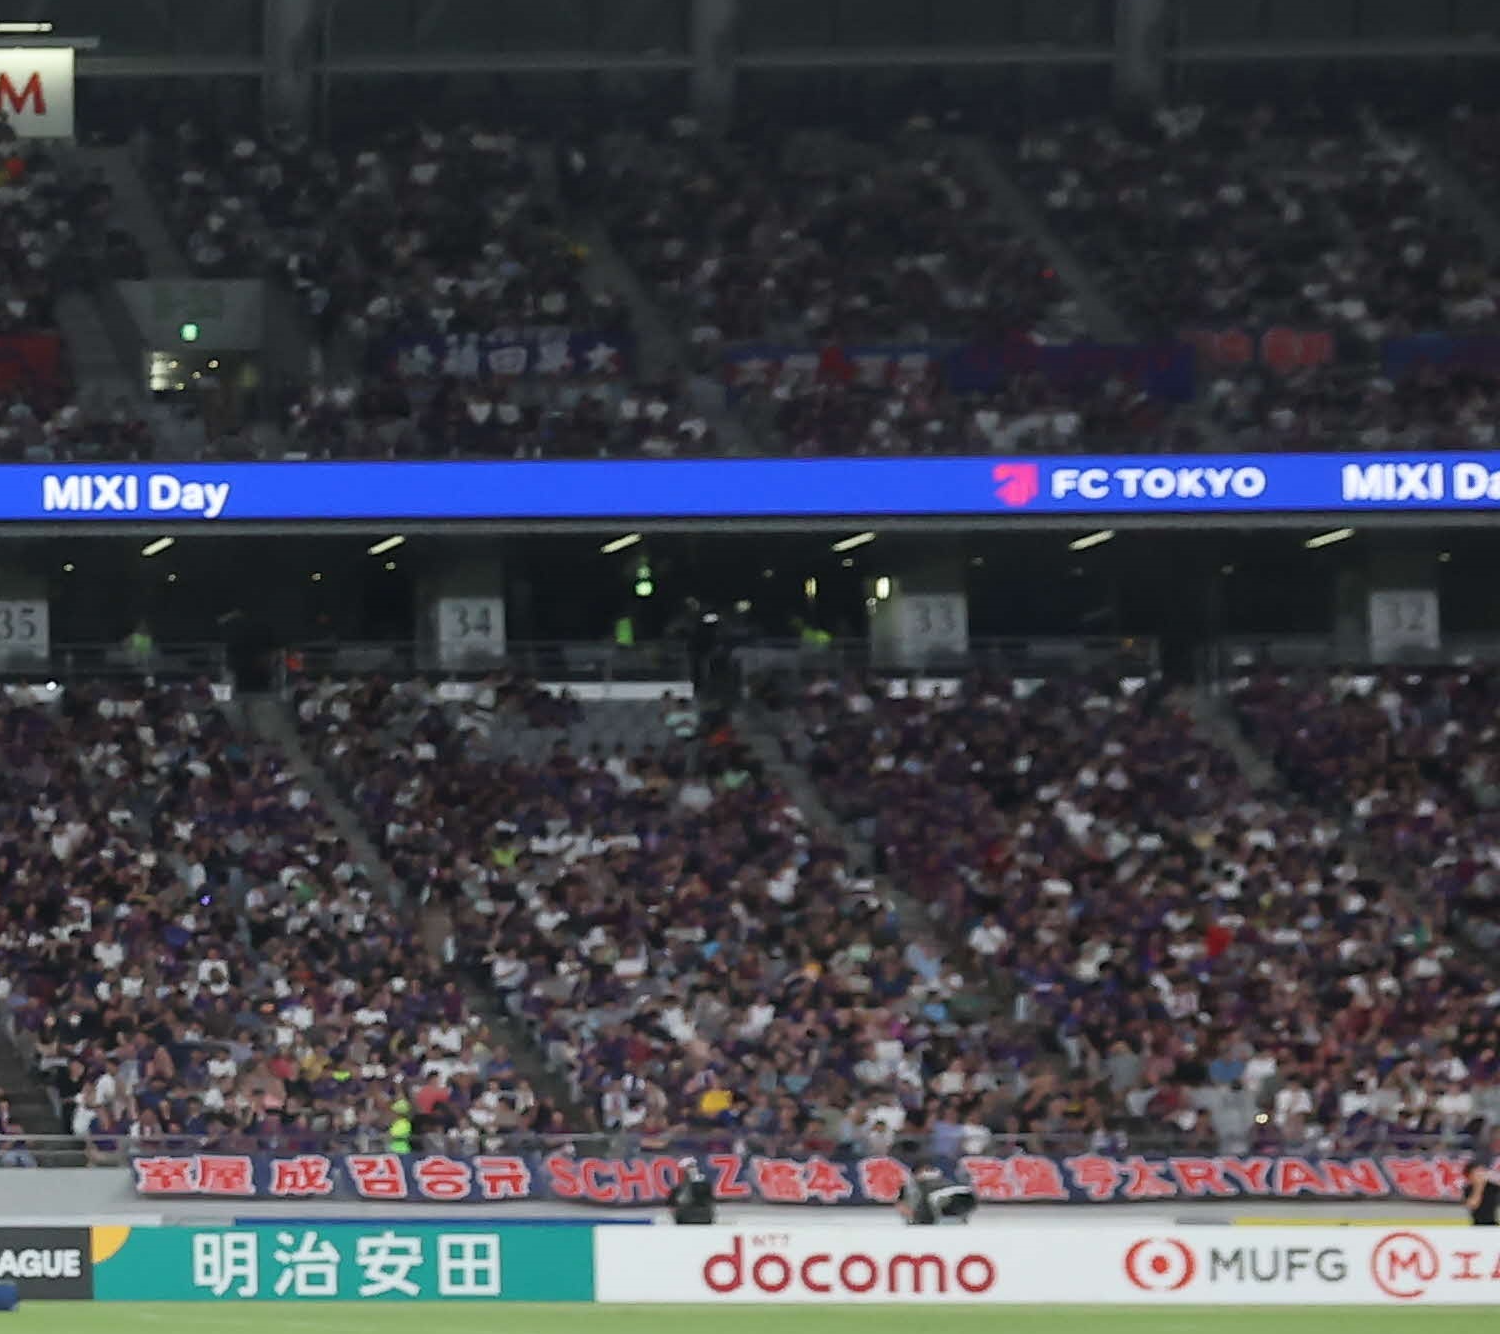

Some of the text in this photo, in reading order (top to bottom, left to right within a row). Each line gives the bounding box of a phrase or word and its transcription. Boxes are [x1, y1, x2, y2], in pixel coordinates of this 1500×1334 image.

[42, 475, 230, 519] MIXI Day
[1050, 466, 1267, 499] FC TOKYO
[1341, 463, 1500, 501] MIXI Da
[451, 605, 491, 639] 34
[547, 1155, 751, 1202] SCHOZ
[1168, 1156, 1390, 1197] RYAN
[192, 1231, 501, 1297] 明治安田
[704, 1235, 997, 1293] docomo
[1211, 1249, 1347, 1282] MUFG
